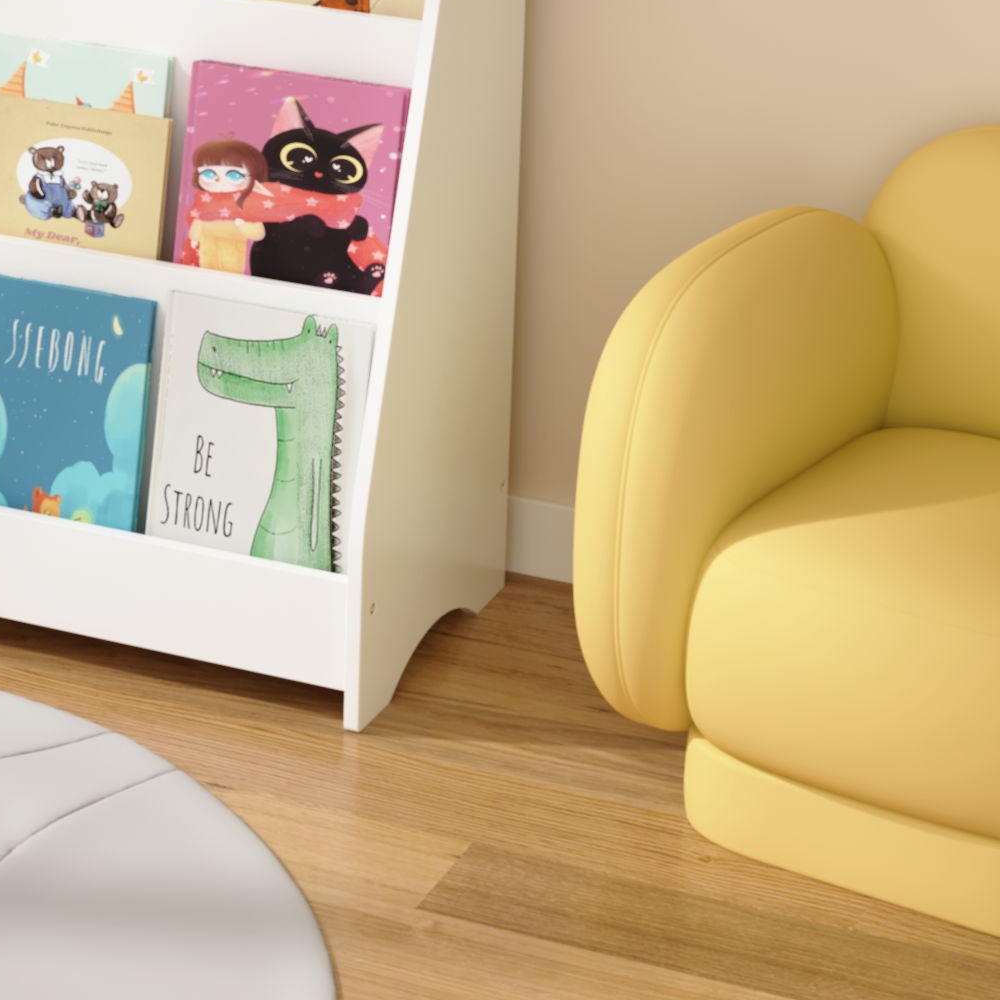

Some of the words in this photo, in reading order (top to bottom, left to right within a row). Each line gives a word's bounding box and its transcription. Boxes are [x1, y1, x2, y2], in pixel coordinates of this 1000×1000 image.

[24, 227, 45, 239] My
[3, 318, 106, 385] SSEBONG
[193, 434, 215, 478] BE
[159, 483, 234, 538] STRONG
